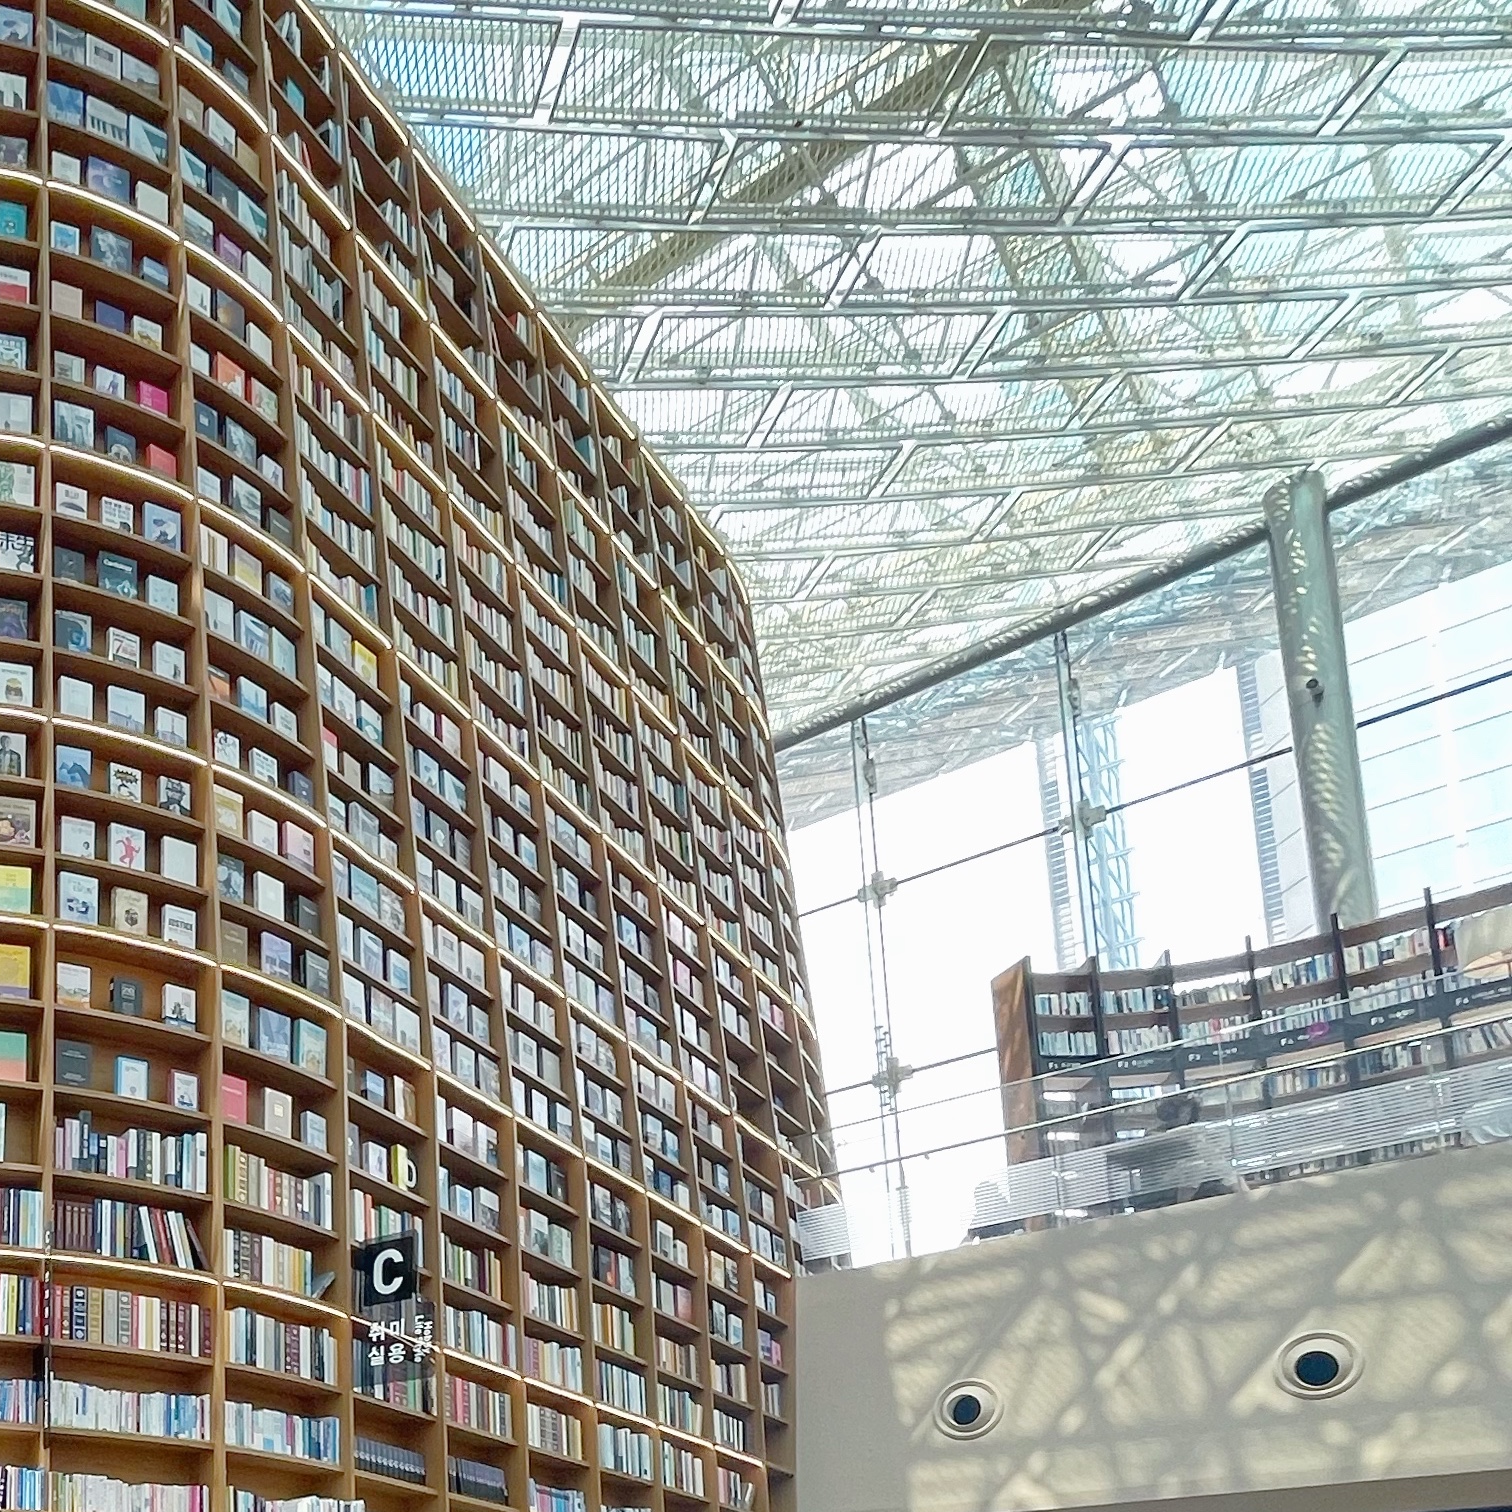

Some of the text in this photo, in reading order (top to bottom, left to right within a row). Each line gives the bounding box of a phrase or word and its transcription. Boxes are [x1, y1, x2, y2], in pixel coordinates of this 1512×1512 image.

[373, 1249, 404, 1295] C
[369, 1318, 405, 1341] 취미
[368, 1343, 406, 1367] 실용
